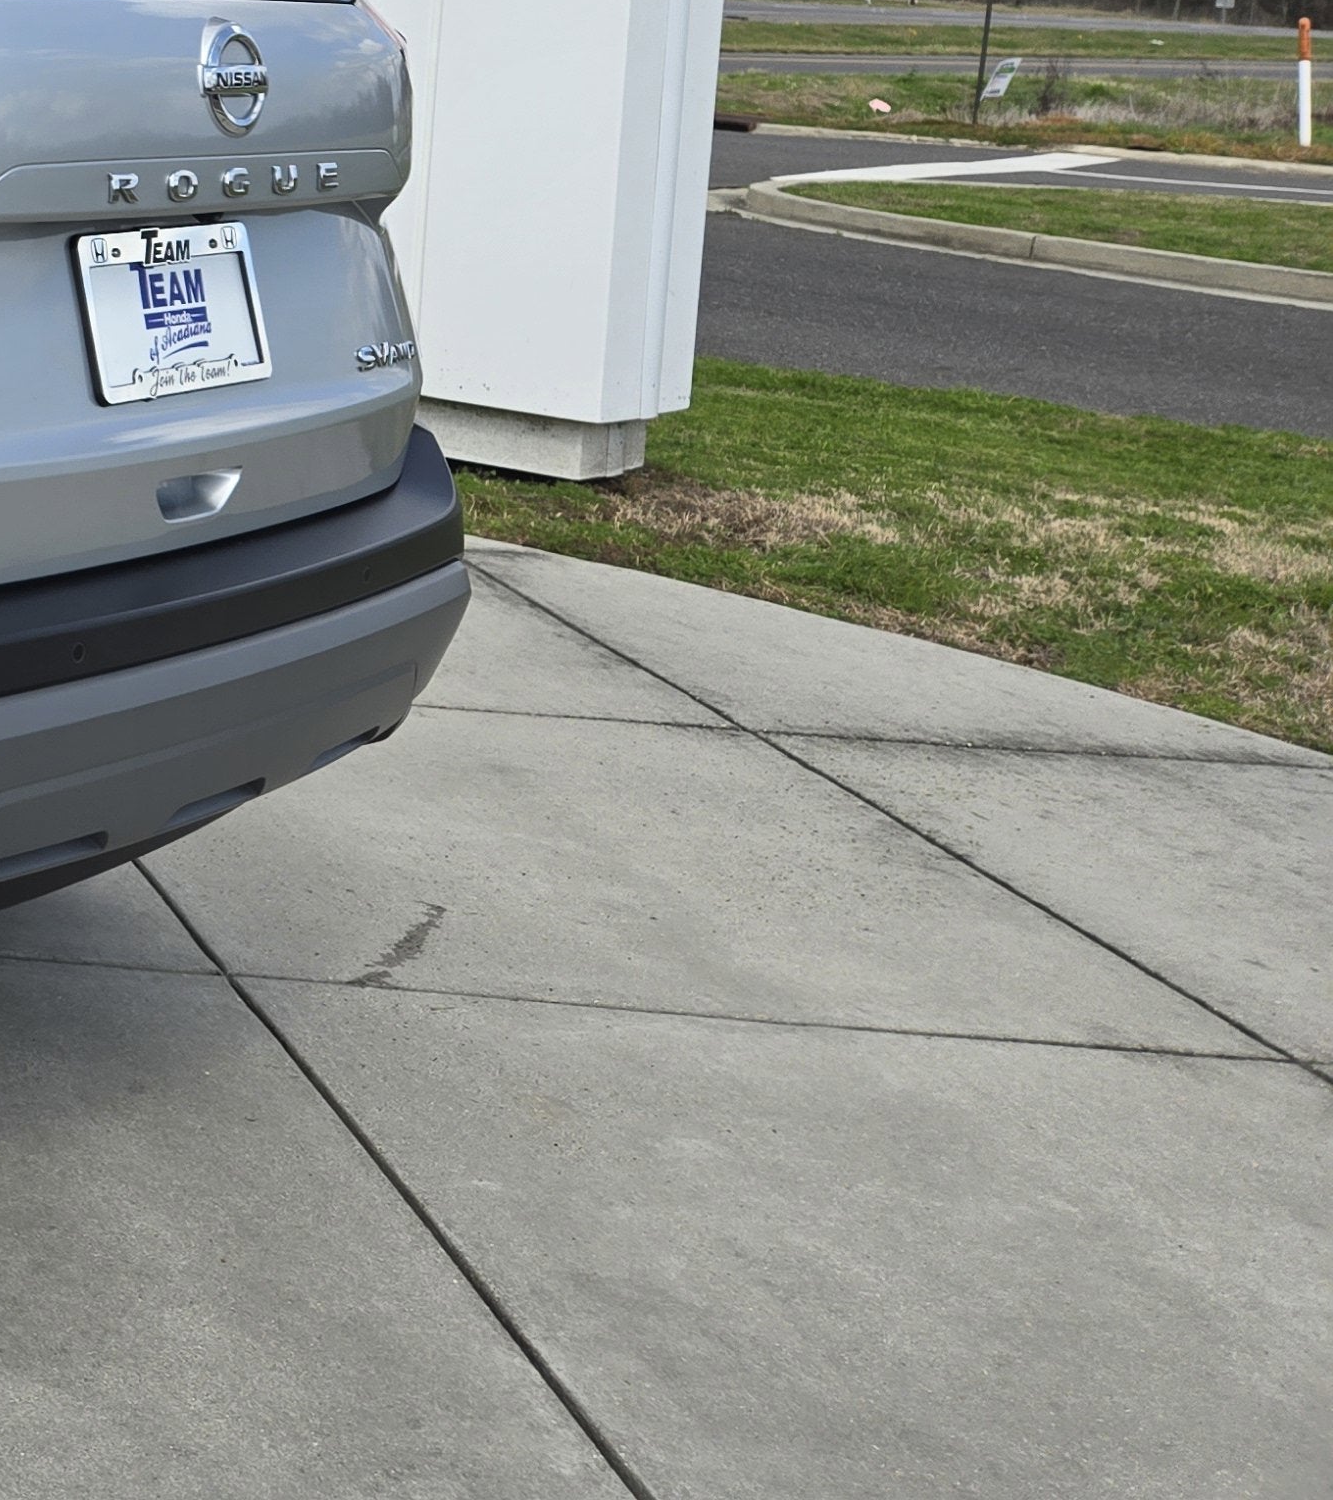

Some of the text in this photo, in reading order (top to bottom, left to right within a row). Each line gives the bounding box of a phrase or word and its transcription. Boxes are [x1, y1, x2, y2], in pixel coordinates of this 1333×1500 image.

[216, 71, 266, 88] NISSAN
[108, 161, 340, 204] ROGUE
[141, 229, 191, 265] TEAM
[130, 263, 206, 310] TEAM
[164, 311, 192, 326] Honda
[161, 321, 212, 351] Acadiana
